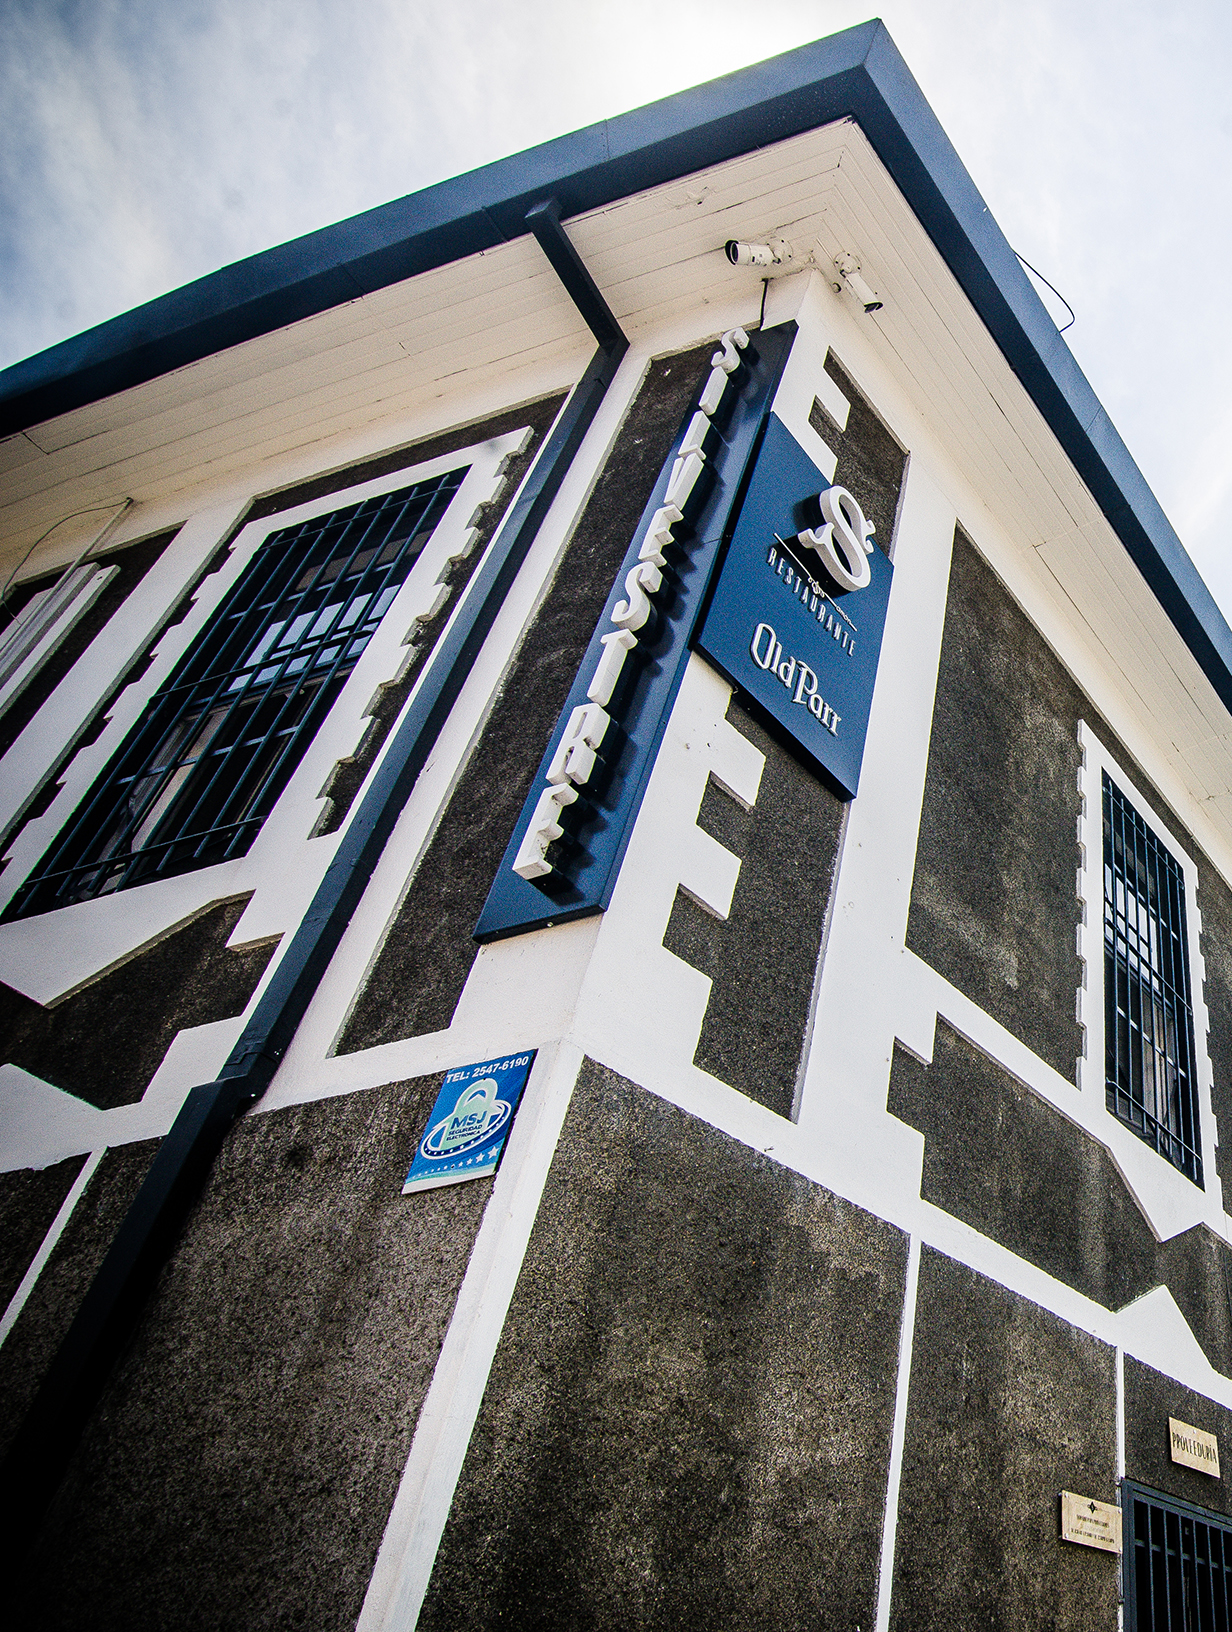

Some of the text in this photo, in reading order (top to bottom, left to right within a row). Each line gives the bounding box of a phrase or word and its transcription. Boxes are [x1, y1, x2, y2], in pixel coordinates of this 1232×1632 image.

[511, 327, 750, 880] SILVESTRE
[766, 547, 857, 657] RESTAURANTE
[750, 623, 842, 737] Old Parr
[446, 1056, 529, 1084] TEL: 2547-6190
[448, 1124, 483, 1136] SEGURIDAD
[450, 1110, 487, 1130] MSJ
